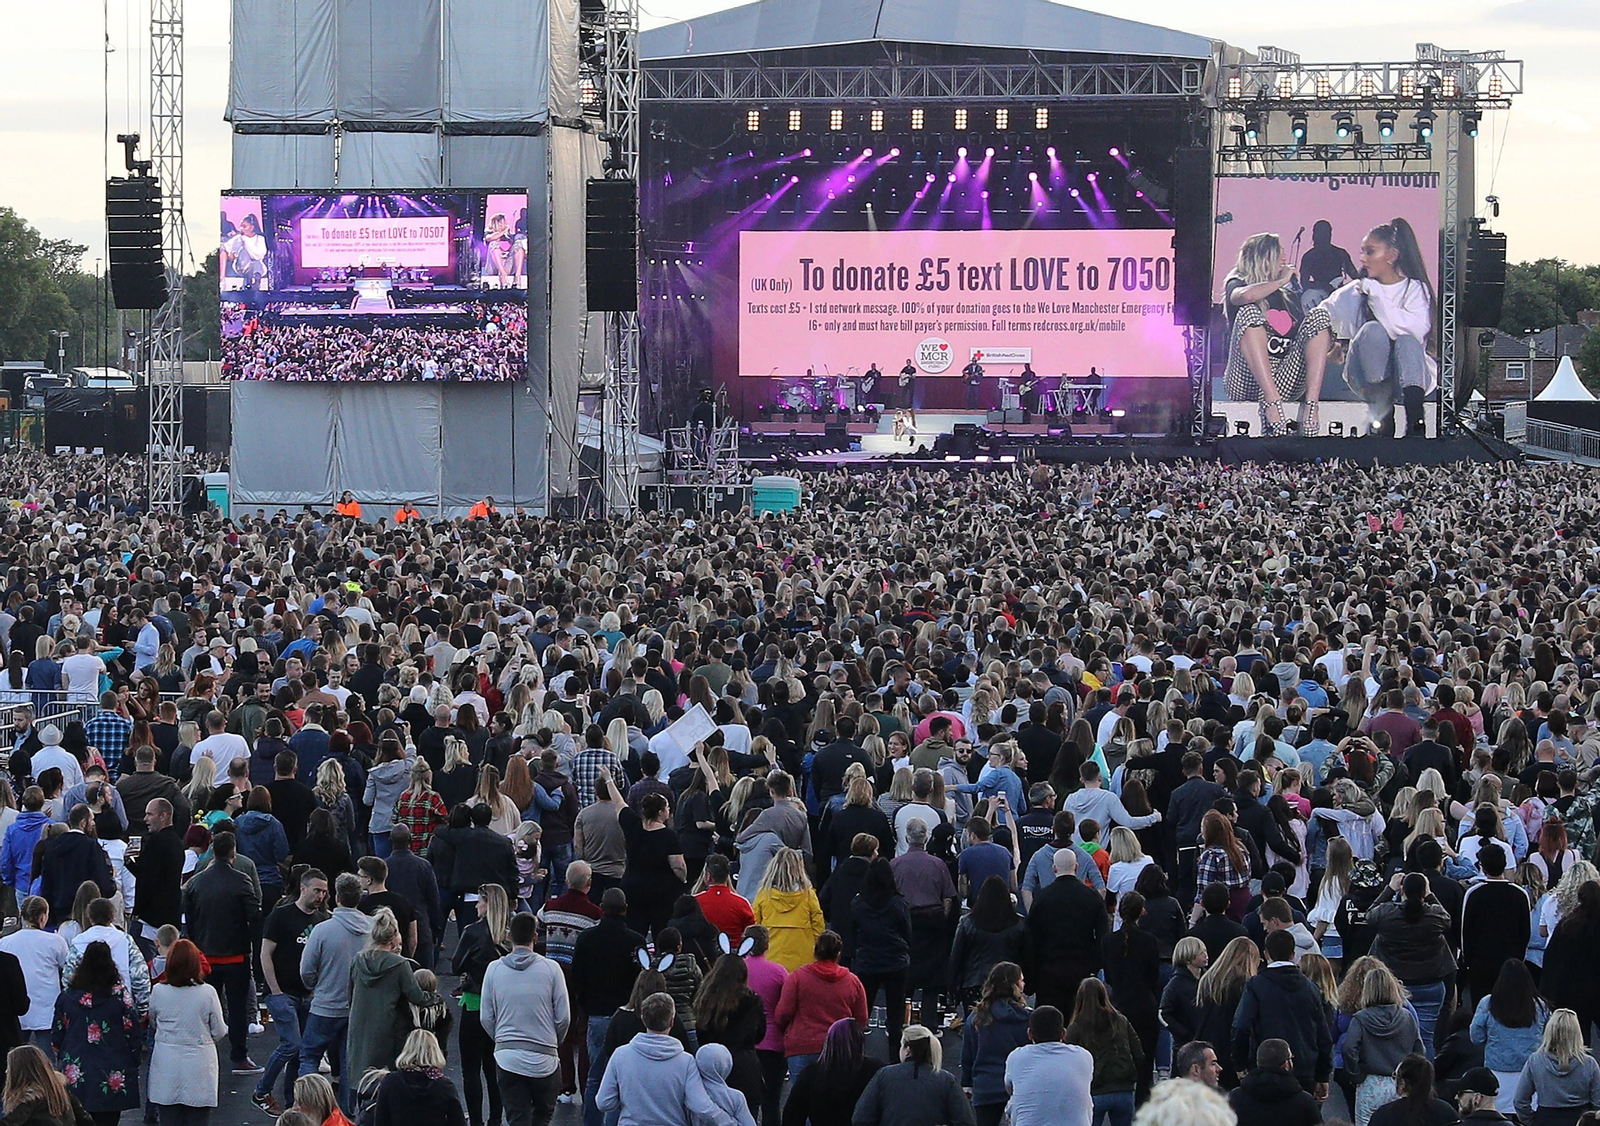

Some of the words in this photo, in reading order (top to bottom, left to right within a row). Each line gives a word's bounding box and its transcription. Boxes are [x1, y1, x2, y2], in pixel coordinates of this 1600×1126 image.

[321, 228, 330, 239] To
[332, 228, 357, 239] donate
[358, 227, 370, 239] £5
[372, 228, 386, 239] text
[388, 227, 408, 239] LOVE
[409, 228, 417, 239] to
[419, 226, 445, 239] 70507
[751, 277, 768, 293] (UK
[769, 277, 793, 294] Only)
[799, 258, 825, 291] To
[832, 258, 909, 291] donate
[915, 257, 951, 291] £5
[957, 262, 1003, 291] text
[1010, 257, 1070, 291] LOVE
[1076, 261, 1099, 291] to
[1107, 257, 1174, 291] 7050
[747, 302, 769, 314] Texts
[770, 302, 787, 314] cost
[788, 301, 801, 314] £5
[814, 302, 828, 314] std
[829, 302, 862, 314] network
[863, 302, 899, 316] message.
[901, 301, 925, 314] 100%
[926, 302, 935, 314] of
[936, 303, 954, 316] your
[956, 302, 991, 314] donation
[992, 303, 1010, 316] goes
[1012, 302, 1021, 314] to
[1022, 302, 1036, 314] the
[1037, 302, 1051, 314] We
[1052, 302, 1070, 314] Love
[1072, 302, 1120, 314] Manchester
[1121, 302, 1166, 317] Emergency
[824, 319, 841, 334] only
[842, 319, 857, 331] and
[858, 319, 878, 331] must
[879, 319, 899, 331] have
[900, 319, 913, 331] bill
[914, 319, 943, 334] payer's
[944, 319, 990, 334] permission.
[991, 319, 1007, 331] Full
[1008, 320, 1032, 331] terms
[1033, 319, 1126, 334] redcross.org.uk/mobile
[920, 343, 938, 352] WE
[920, 352, 949, 361] MCR
[1022, 826, 1054, 835] TRIUMPH
